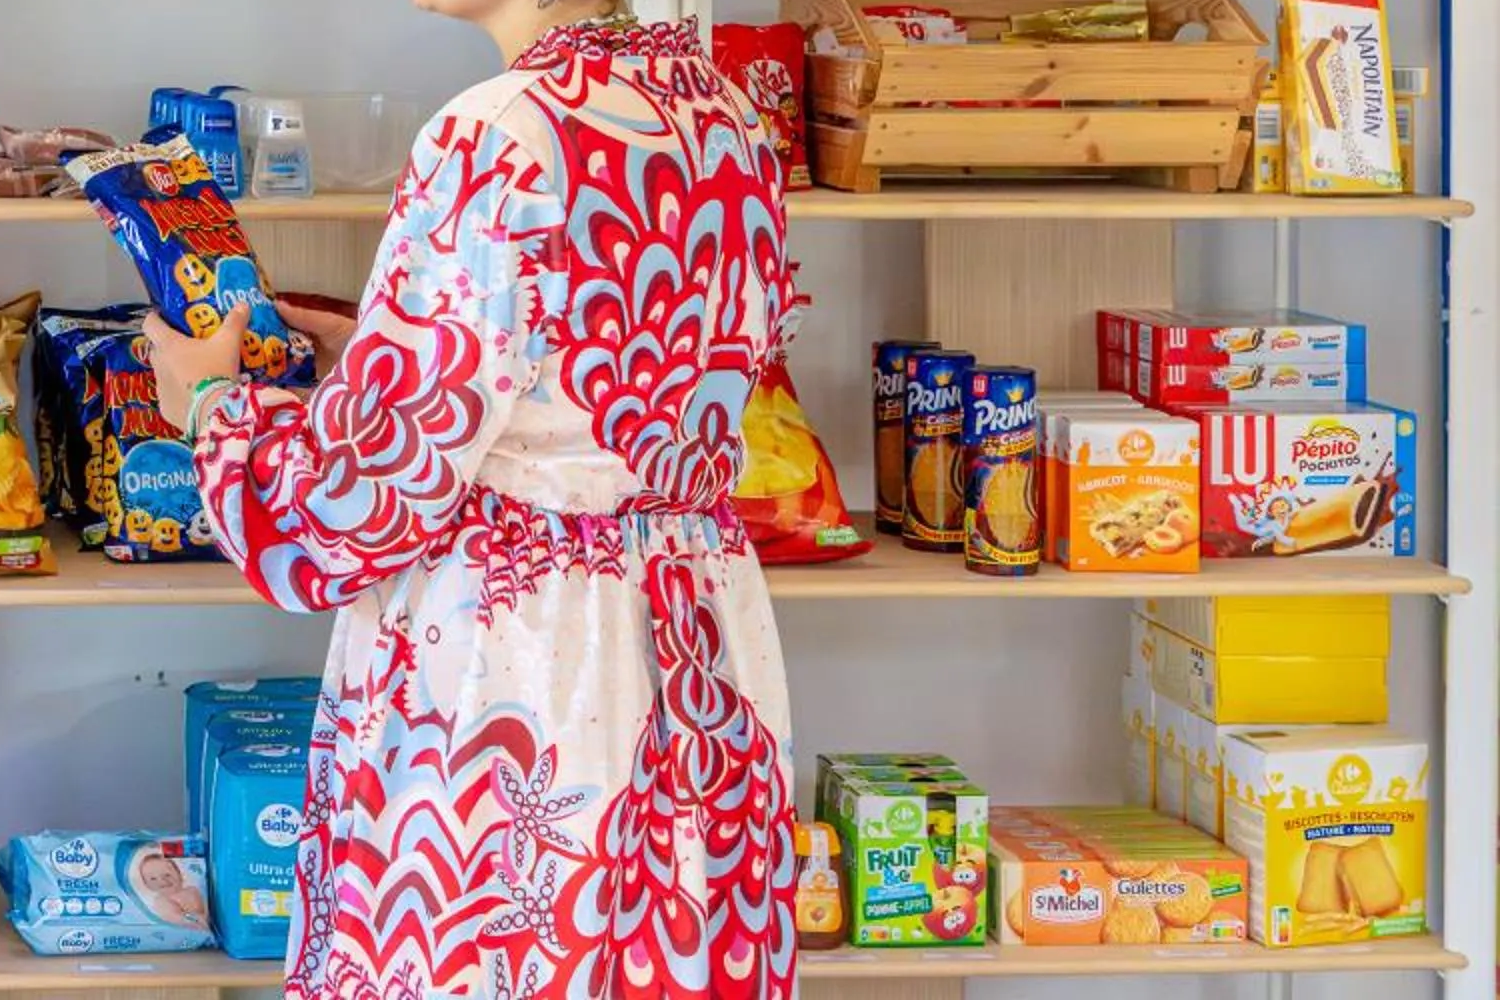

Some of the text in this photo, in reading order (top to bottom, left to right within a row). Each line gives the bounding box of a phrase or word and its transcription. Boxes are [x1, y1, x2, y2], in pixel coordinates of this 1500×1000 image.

[1350, 23, 1384, 138] NAPOLITAIN
[875, 368, 904, 397] PRI
[906, 381, 961, 416] PRIN
[974, 397, 1038, 436] PRINC
[1210, 414, 1268, 486] LU
[1291, 439, 1358, 464] Pépito
[124, 470, 197, 495] ORIGINA
[261, 818, 300, 835] Baby
[1283, 810, 1415, 831] BISCOTTES BESCHUITEN
[55, 850, 93, 867] Baby
[249, 862, 283, 876] Ultra
[866, 845, 922, 873] FRUIT
[57, 878, 99, 889] FRESH
[1116, 879, 1186, 896] Galettes
[61, 939, 89, 950] Baby
